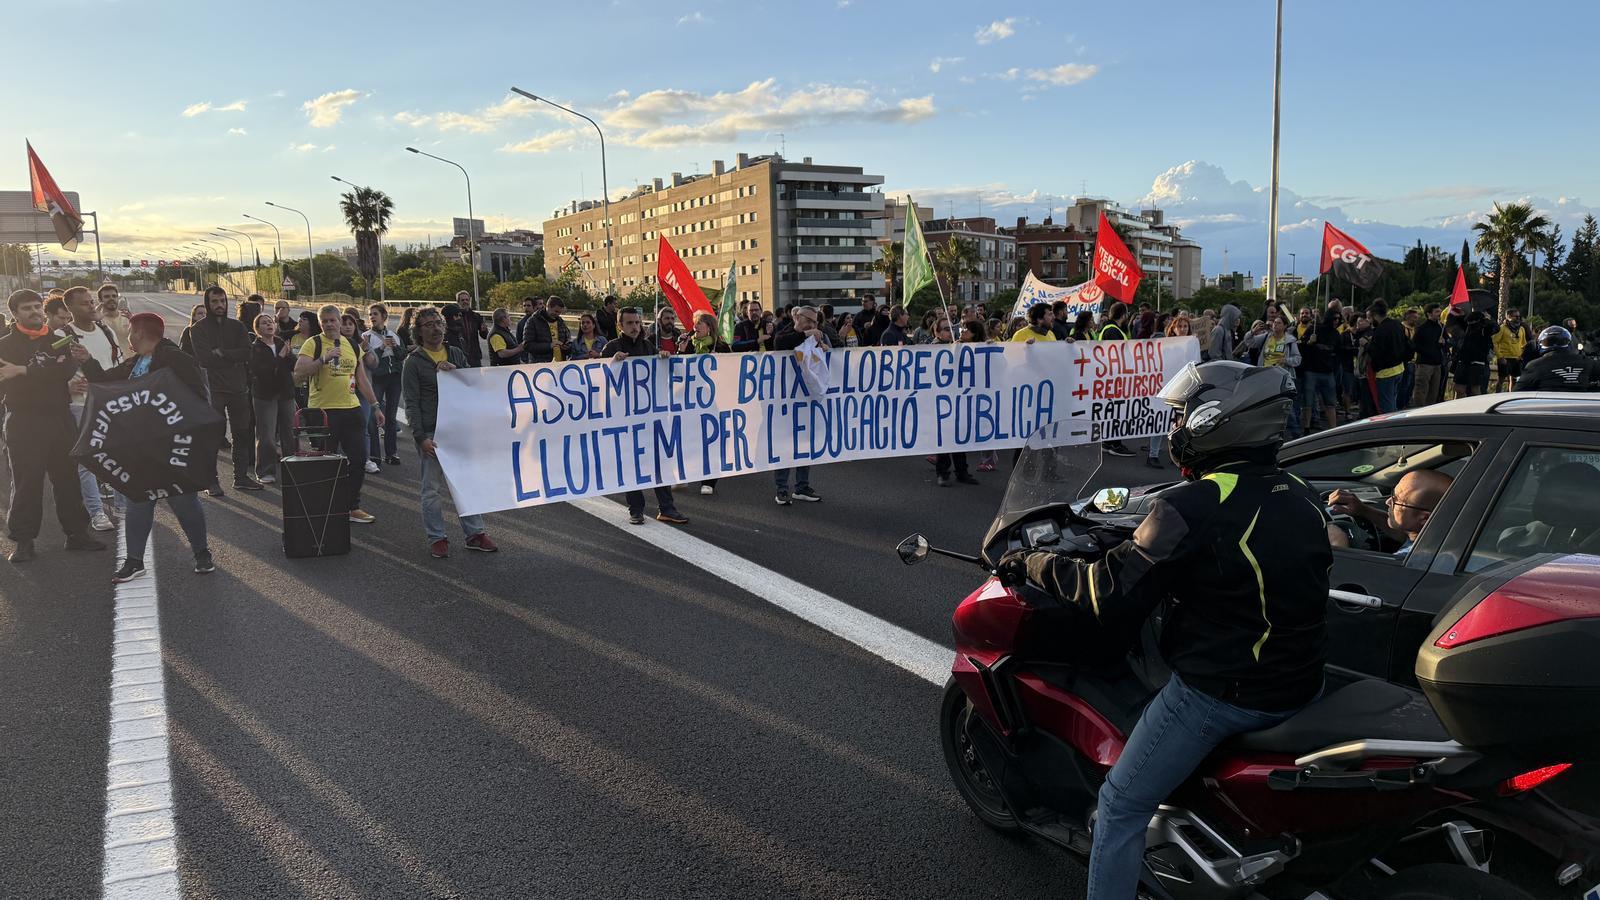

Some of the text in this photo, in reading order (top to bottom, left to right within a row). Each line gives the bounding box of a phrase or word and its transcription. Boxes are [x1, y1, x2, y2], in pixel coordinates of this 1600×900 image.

[1330, 244, 1371, 270] CGT
[1092, 342, 1164, 378] SALARI
[507, 353, 717, 429] ASSEMBLEES
[738, 354, 810, 405] BAIX
[1092, 373, 1164, 401] RECURSOS
[1091, 396, 1150, 422] RÀTIOS
[169, 433, 193, 468] PAE
[511, 379, 1056, 502] LLUITEM PER L'EDUCACIÓ PÚBLICA
